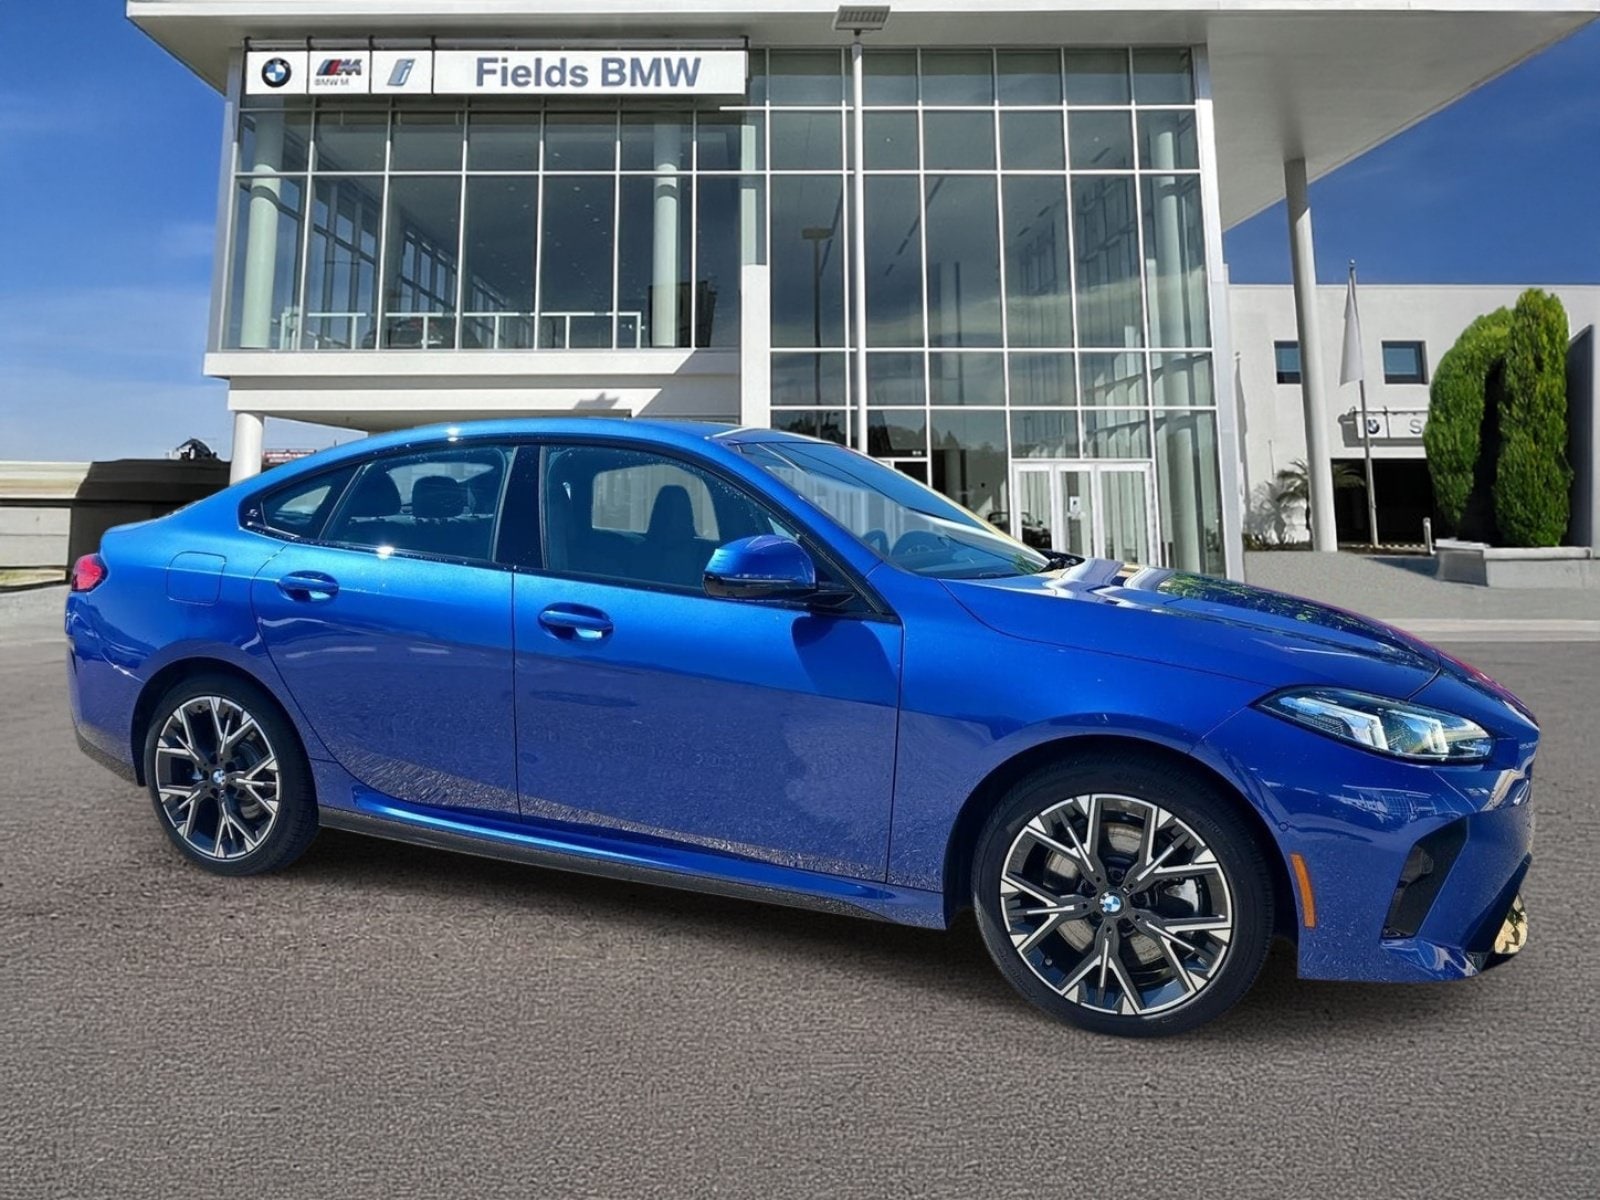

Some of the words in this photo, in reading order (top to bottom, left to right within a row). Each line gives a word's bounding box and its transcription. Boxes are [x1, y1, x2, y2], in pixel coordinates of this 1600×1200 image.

[314, 78, 338, 86] BMW
[475, 57, 589, 88] Fields
[600, 57, 702, 88] BMW
